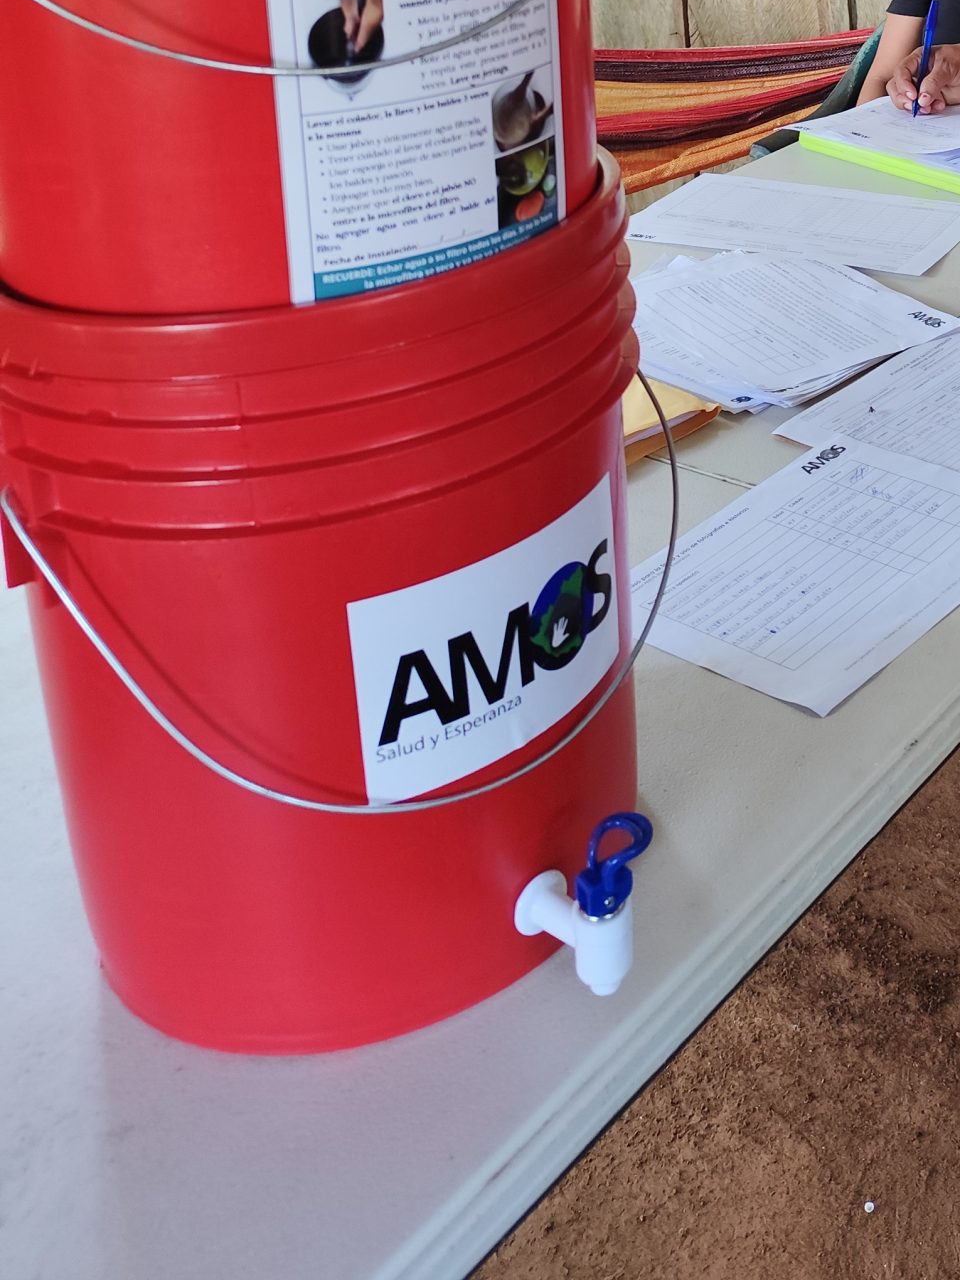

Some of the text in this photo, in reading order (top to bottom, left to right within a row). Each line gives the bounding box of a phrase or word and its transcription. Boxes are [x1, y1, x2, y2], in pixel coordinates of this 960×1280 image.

[907, 311, 946, 328] AMOS
[801, 444, 846, 475] AMOS
[378, 537, 612, 747] AMOS
[376, 694, 522, 763] Salud y Esperanza
